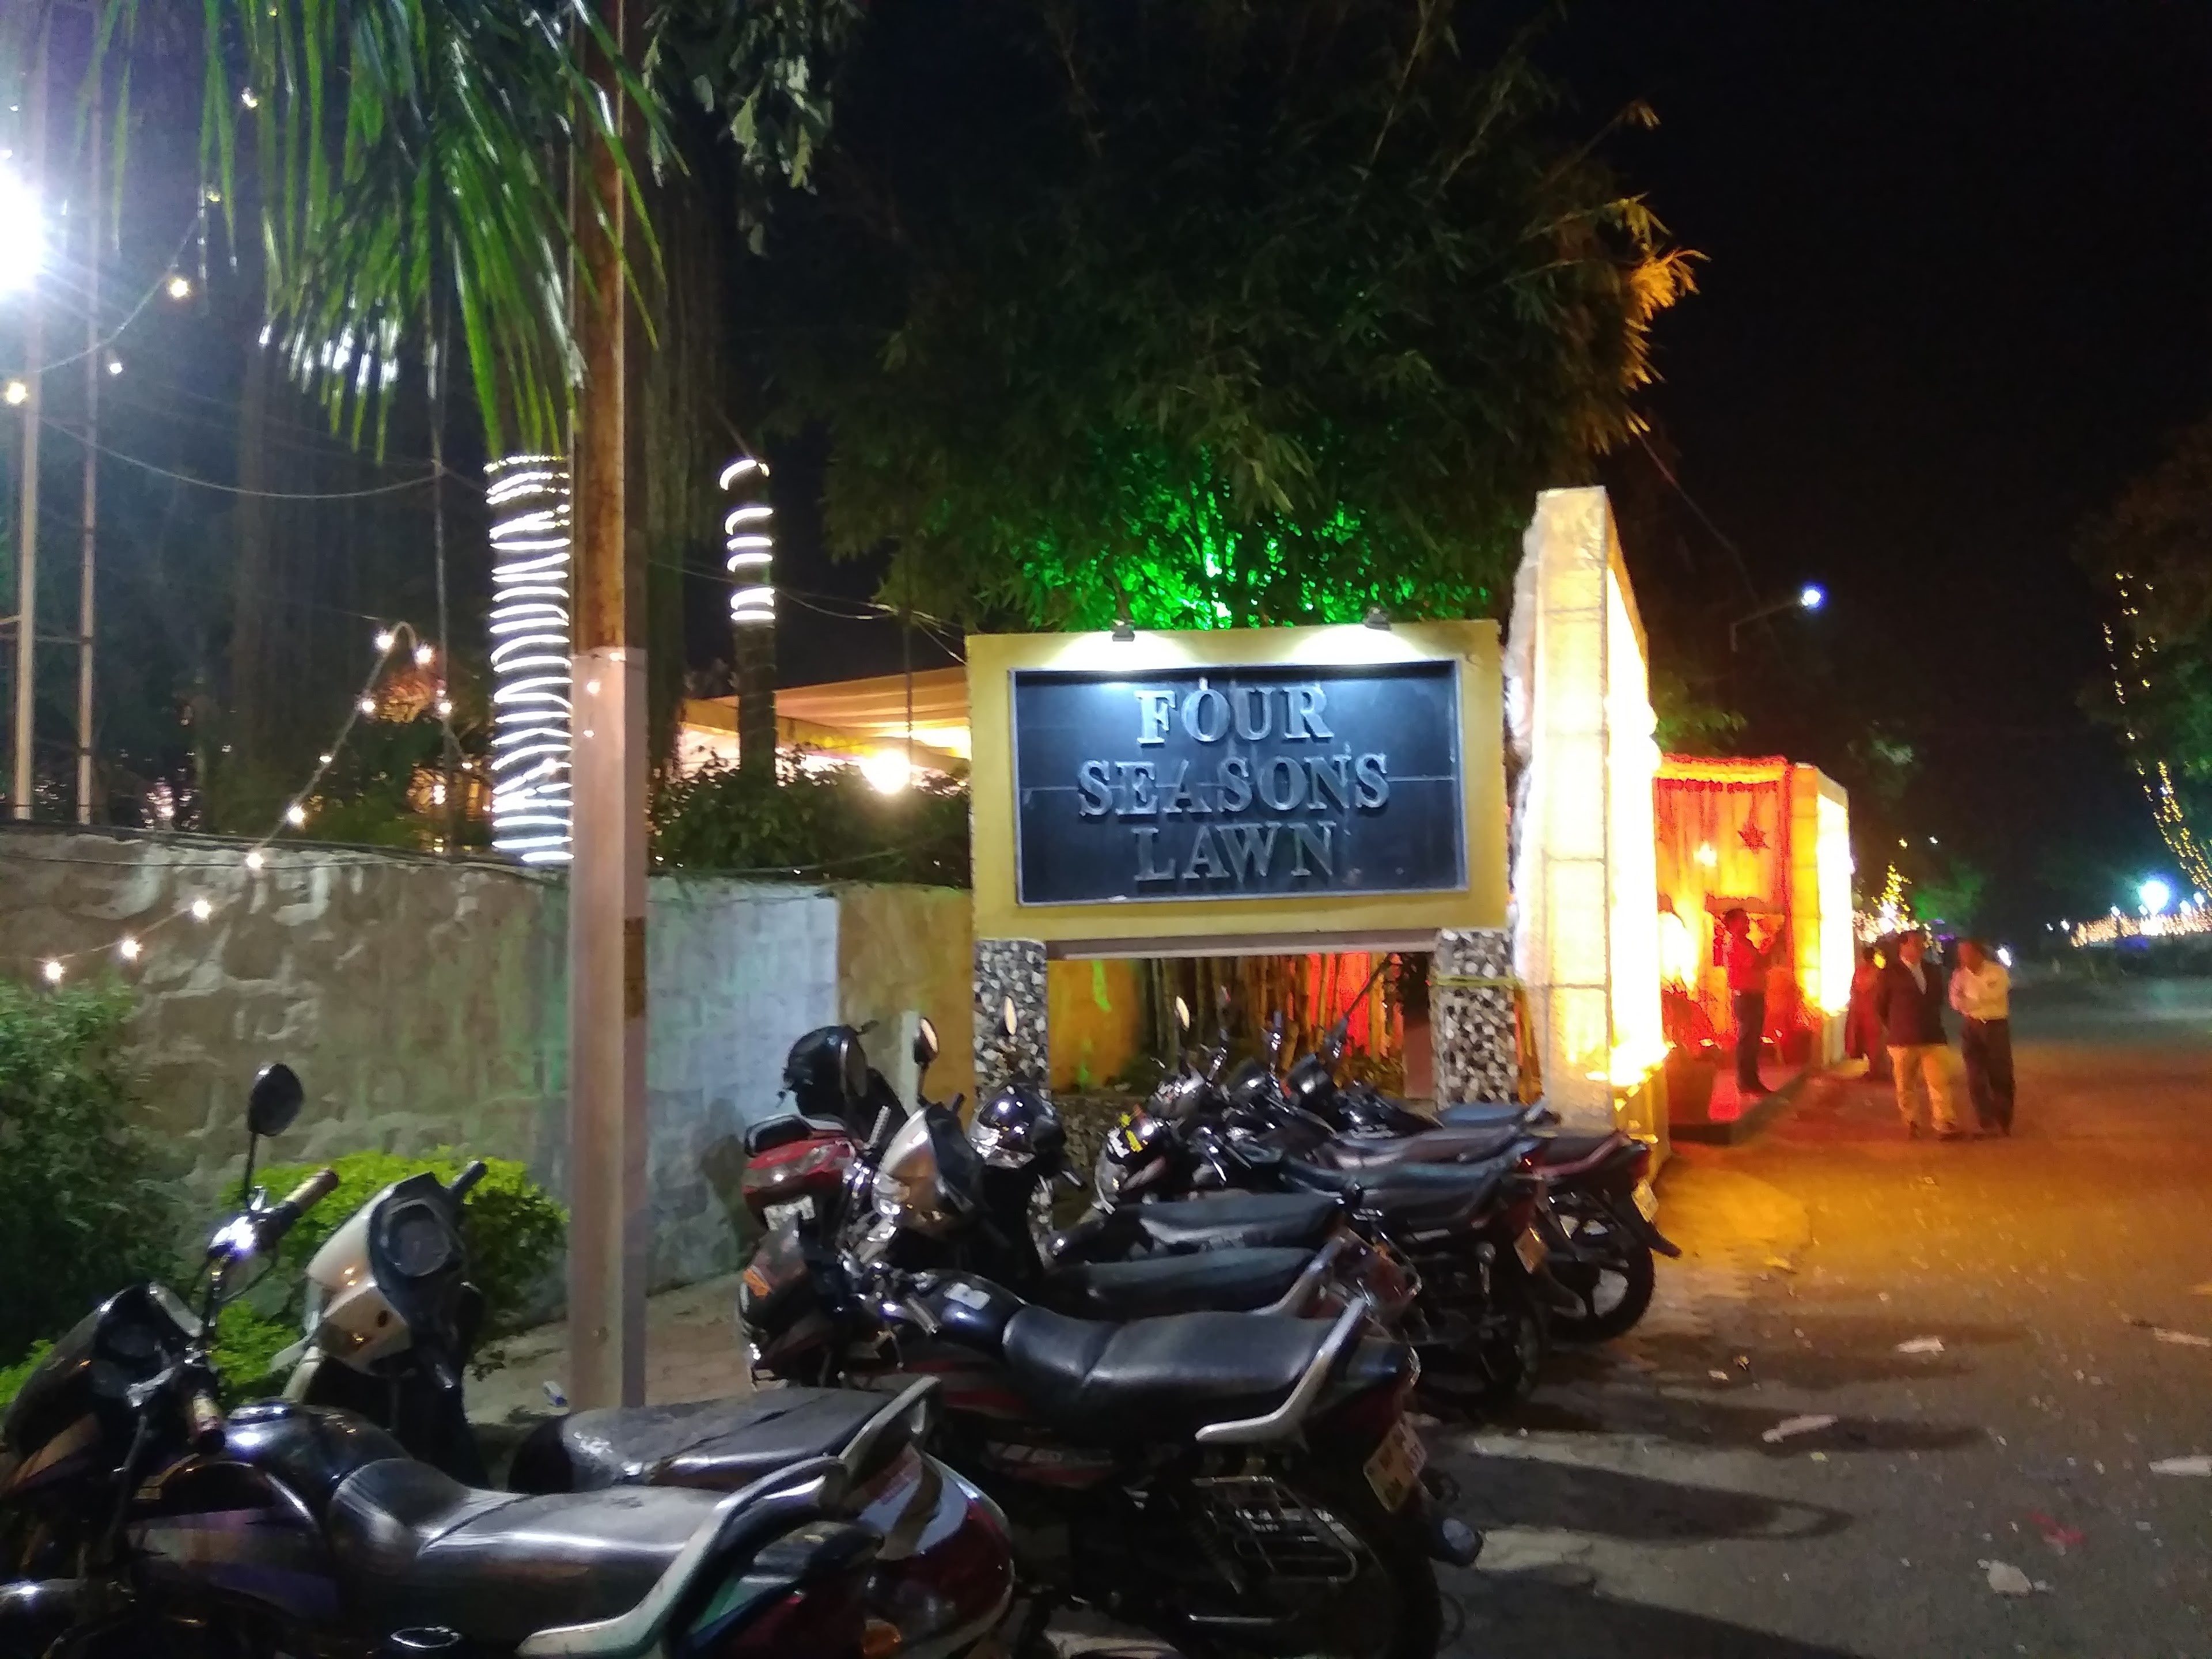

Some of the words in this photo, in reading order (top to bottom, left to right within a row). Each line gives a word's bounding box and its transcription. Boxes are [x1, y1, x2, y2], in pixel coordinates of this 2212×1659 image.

[1134, 685, 1335, 745] FOUR
[1077, 753, 1390, 816] SEASONS
[1131, 820, 1336, 881] LAWN
